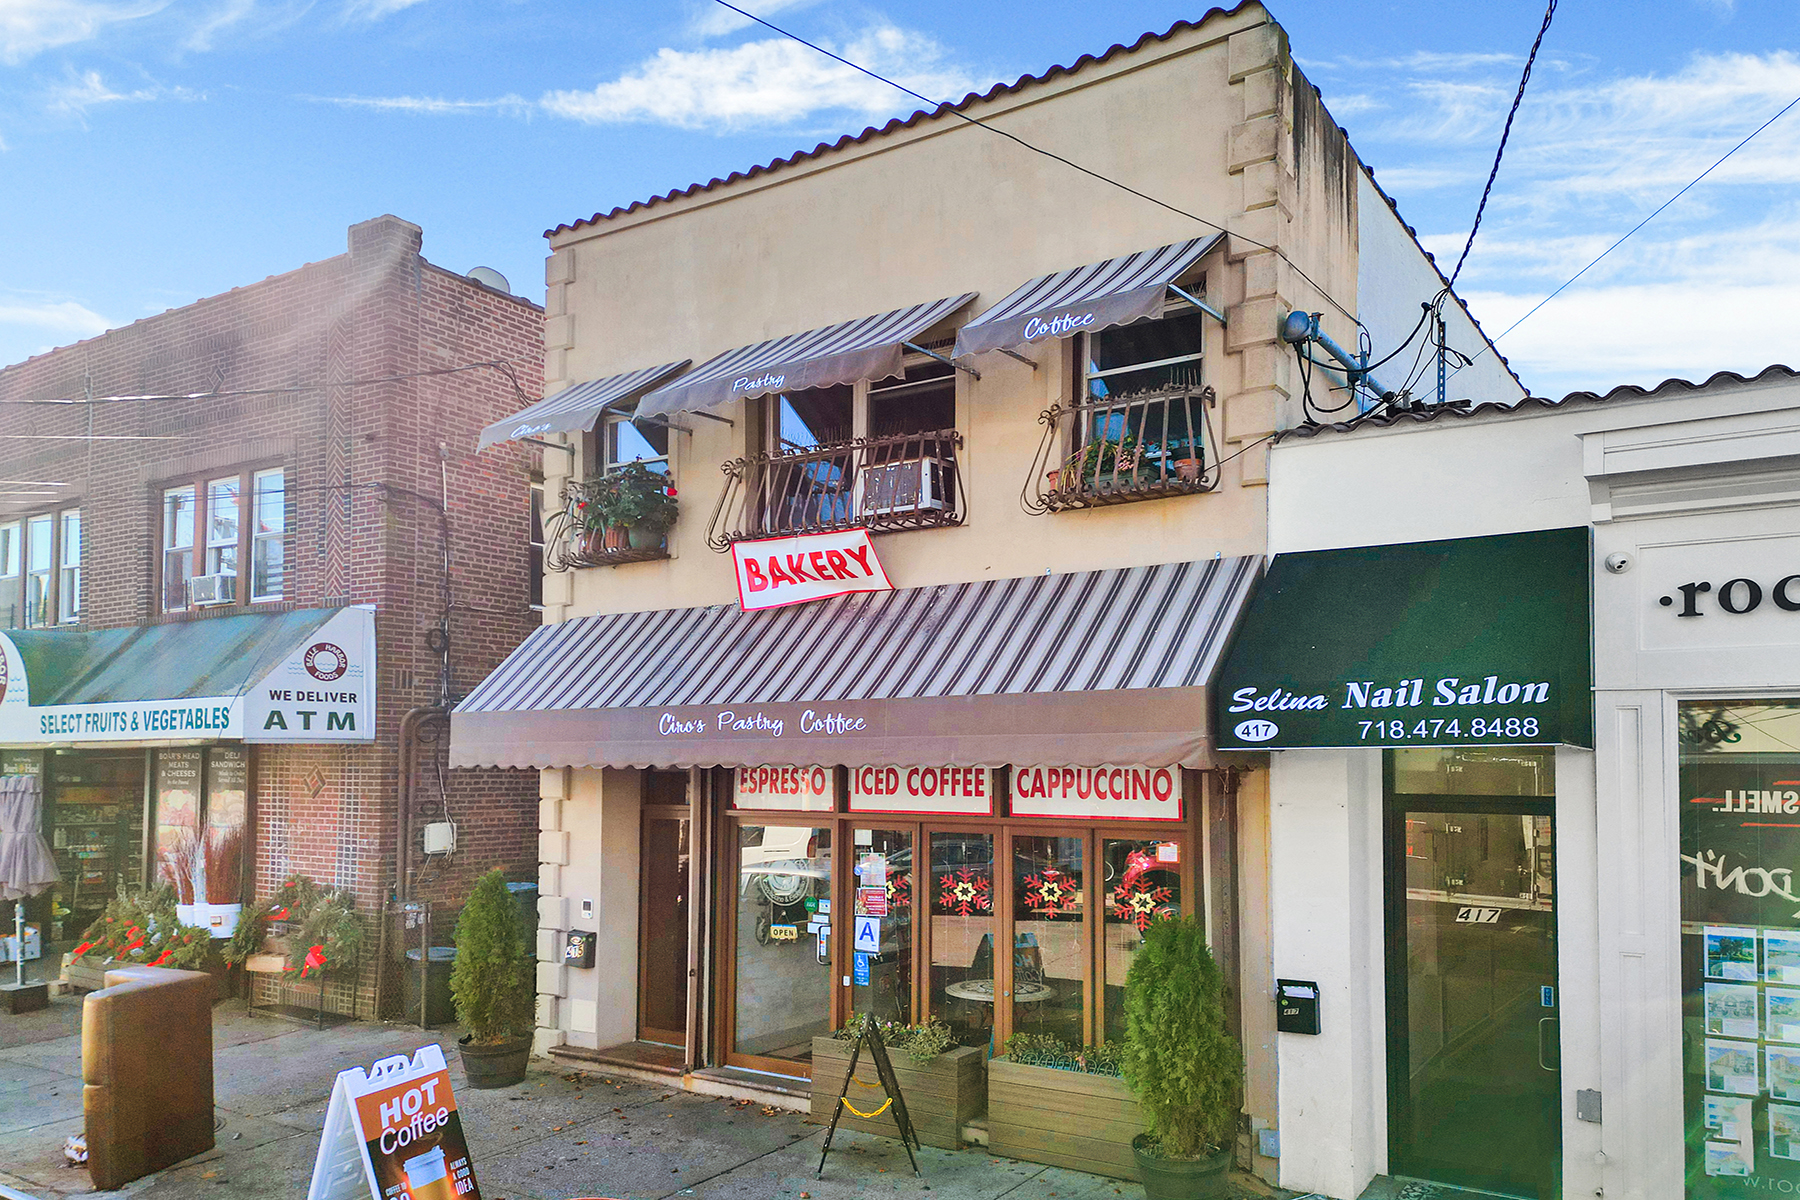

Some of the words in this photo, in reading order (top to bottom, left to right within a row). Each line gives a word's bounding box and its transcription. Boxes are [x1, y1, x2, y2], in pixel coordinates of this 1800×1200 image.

[1024, 313, 1095, 339] Coffee
[732, 372, 785, 392] Pastry
[744, 544, 874, 592] BAKERY
[306, 647, 318, 667] BELLE
[325, 644, 346, 668] HARBOR
[315, 671, 339, 680] FOODS
[269, 690, 291, 701] WE
[296, 691, 357, 703] DELIVER
[1228, 687, 1330, 713] Selina
[1341, 678, 1424, 709] Nail
[1432, 675, 1550, 707] Salon
[40, 713, 82, 735] SELECT
[85, 711, 127, 733] FRUITS
[130, 711, 139, 731] &
[143, 707, 230, 731] VEGETABLES
[263, 710, 356, 731] ATM
[658, 712, 706, 736] Ciro's
[717, 710, 785, 737] Pastry
[799, 709, 867, 734] Coffee
[1241, 723, 1272, 738] 417
[1358, 717, 1540, 740] 718.474.8488
[739, 767, 826, 795] ESPRESSO
[854, 767, 900, 795] ICED
[906, 767, 985, 797] COFFEE
[1016, 768, 1173, 802] CAPPUCCINO
[1458, 909, 1500, 922] 417
[858, 922, 876, 942] A
[380, 1077, 439, 1129] HOT
[380, 1107, 449, 1155] Coffee
[452, 1172, 457, 1180] A
[455, 1177, 474, 1196] IDEA
